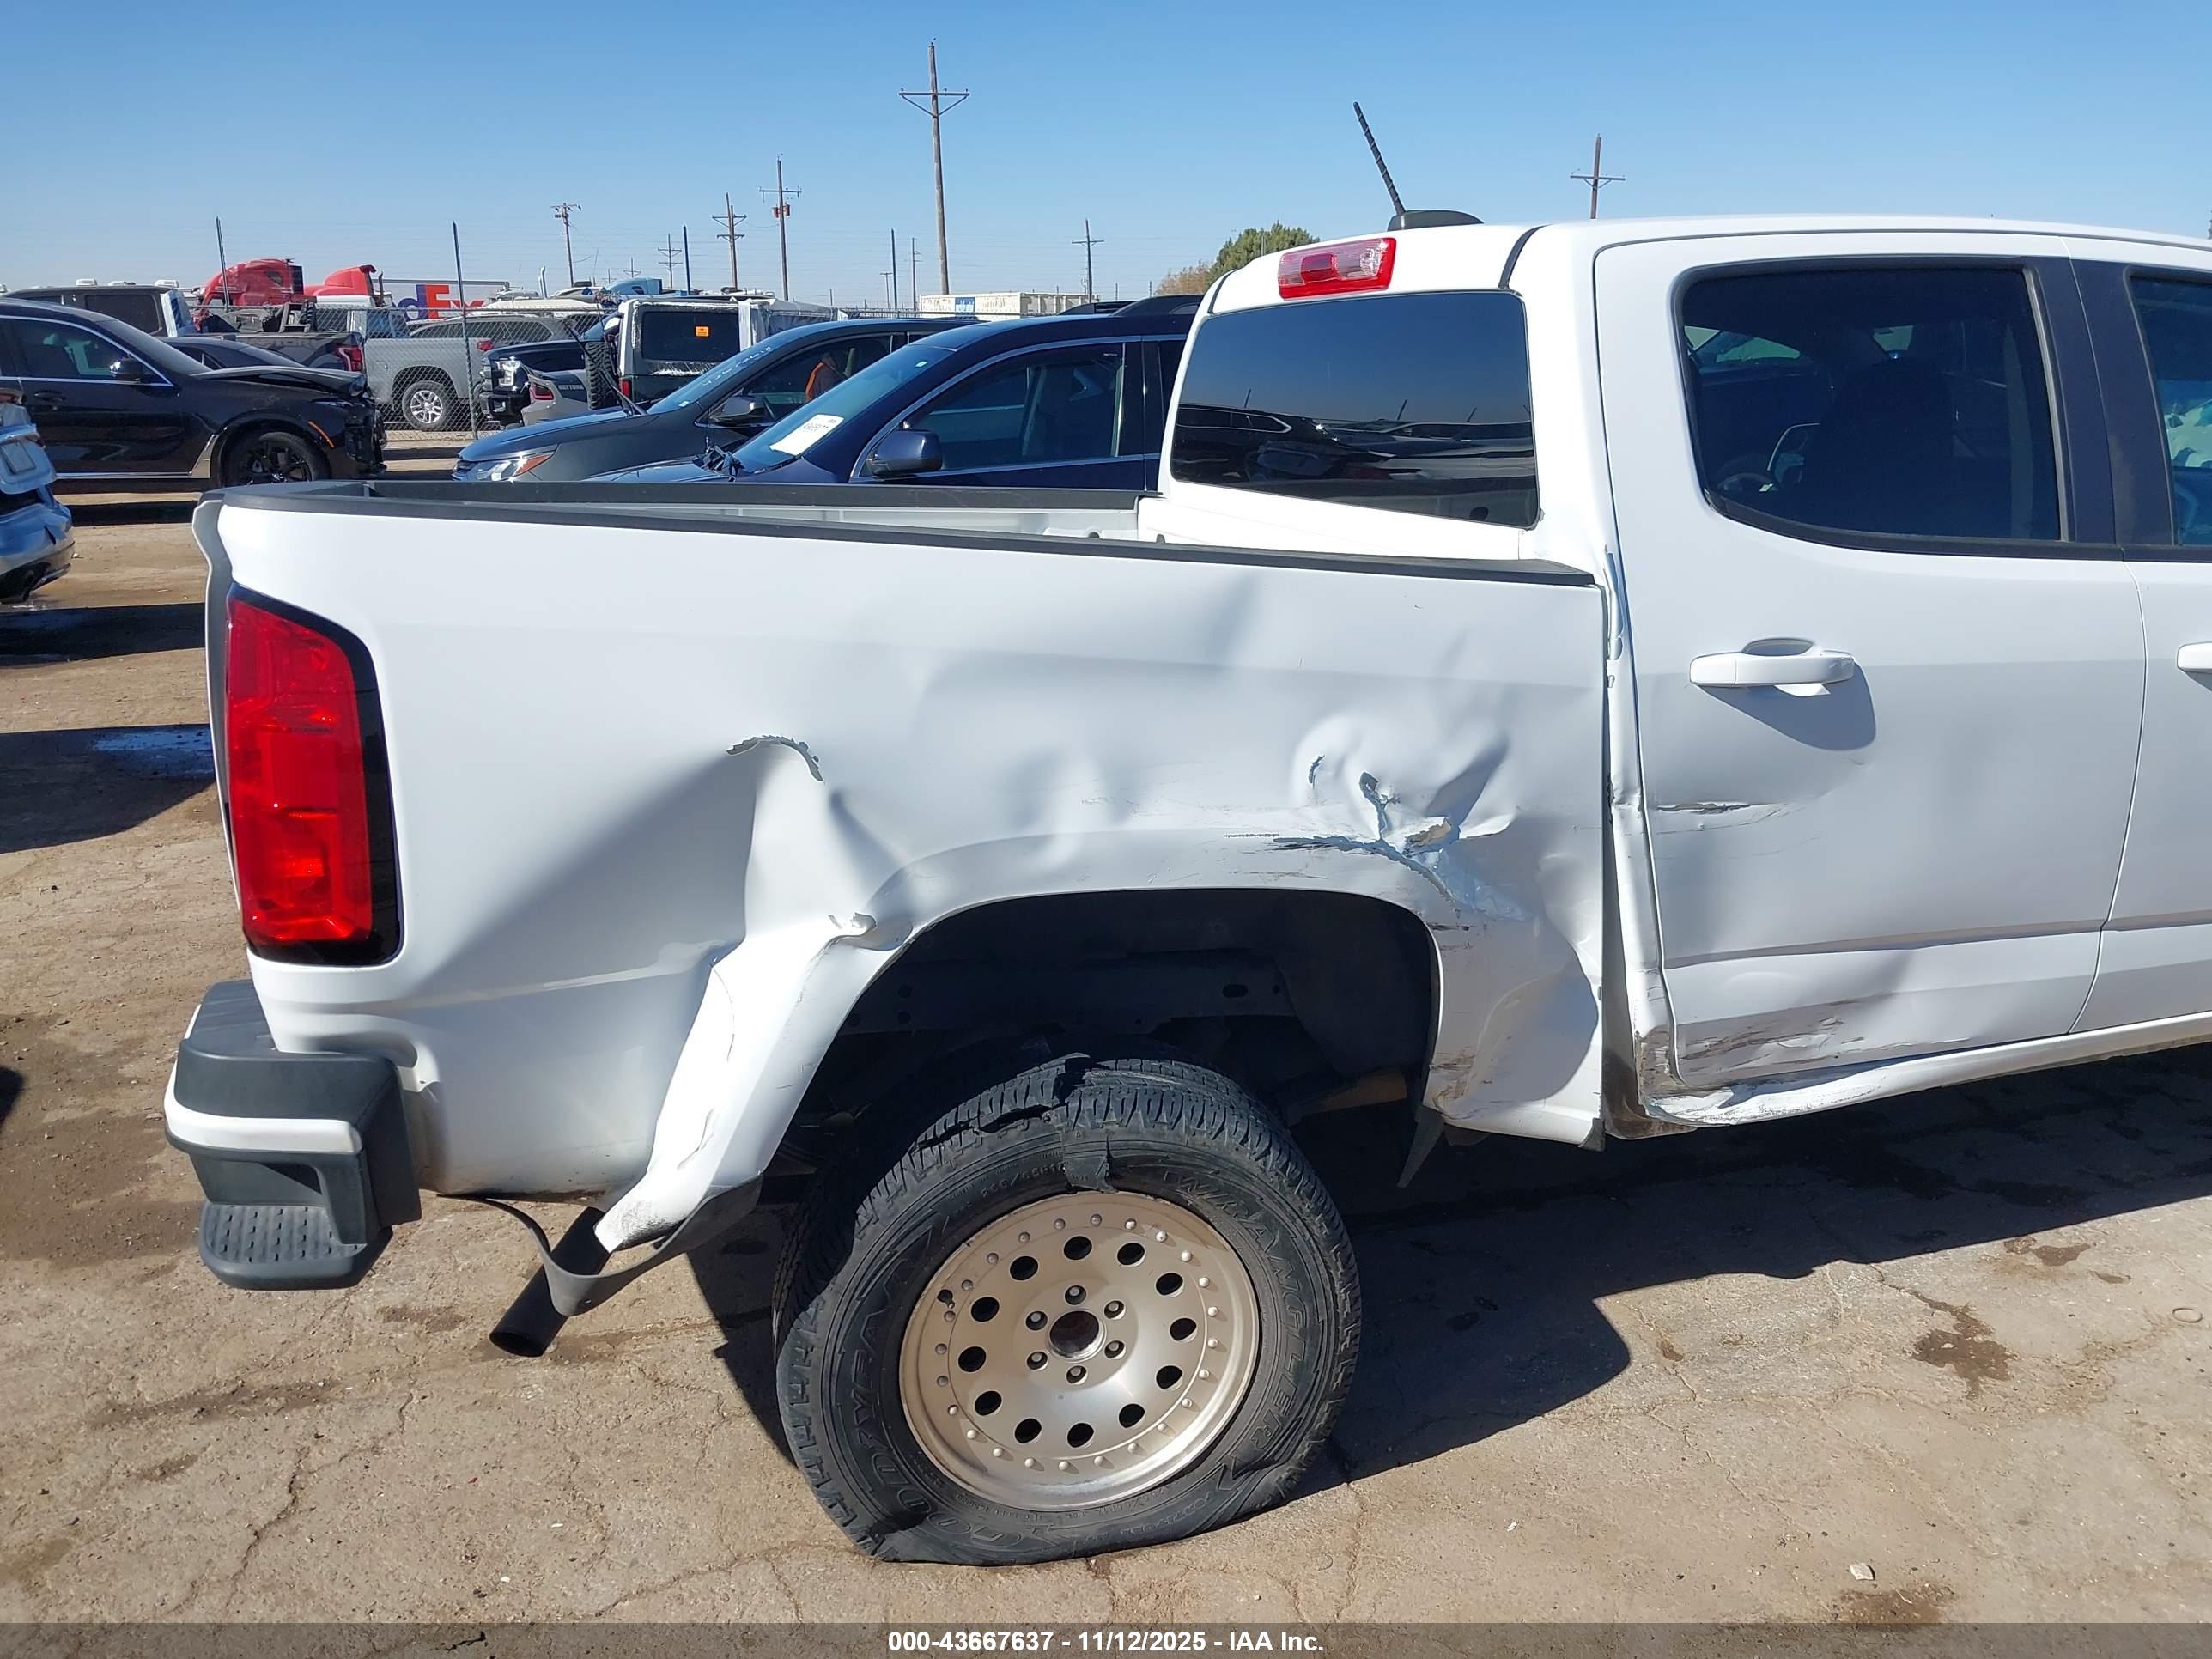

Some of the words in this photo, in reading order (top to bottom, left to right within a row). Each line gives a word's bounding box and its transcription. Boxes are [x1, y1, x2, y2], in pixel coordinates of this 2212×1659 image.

[398, 284, 486, 319] dEx
[849, 1255, 1022, 1549] GOODYEAR
[1163, 1170, 1309, 1451] WRANGLER
